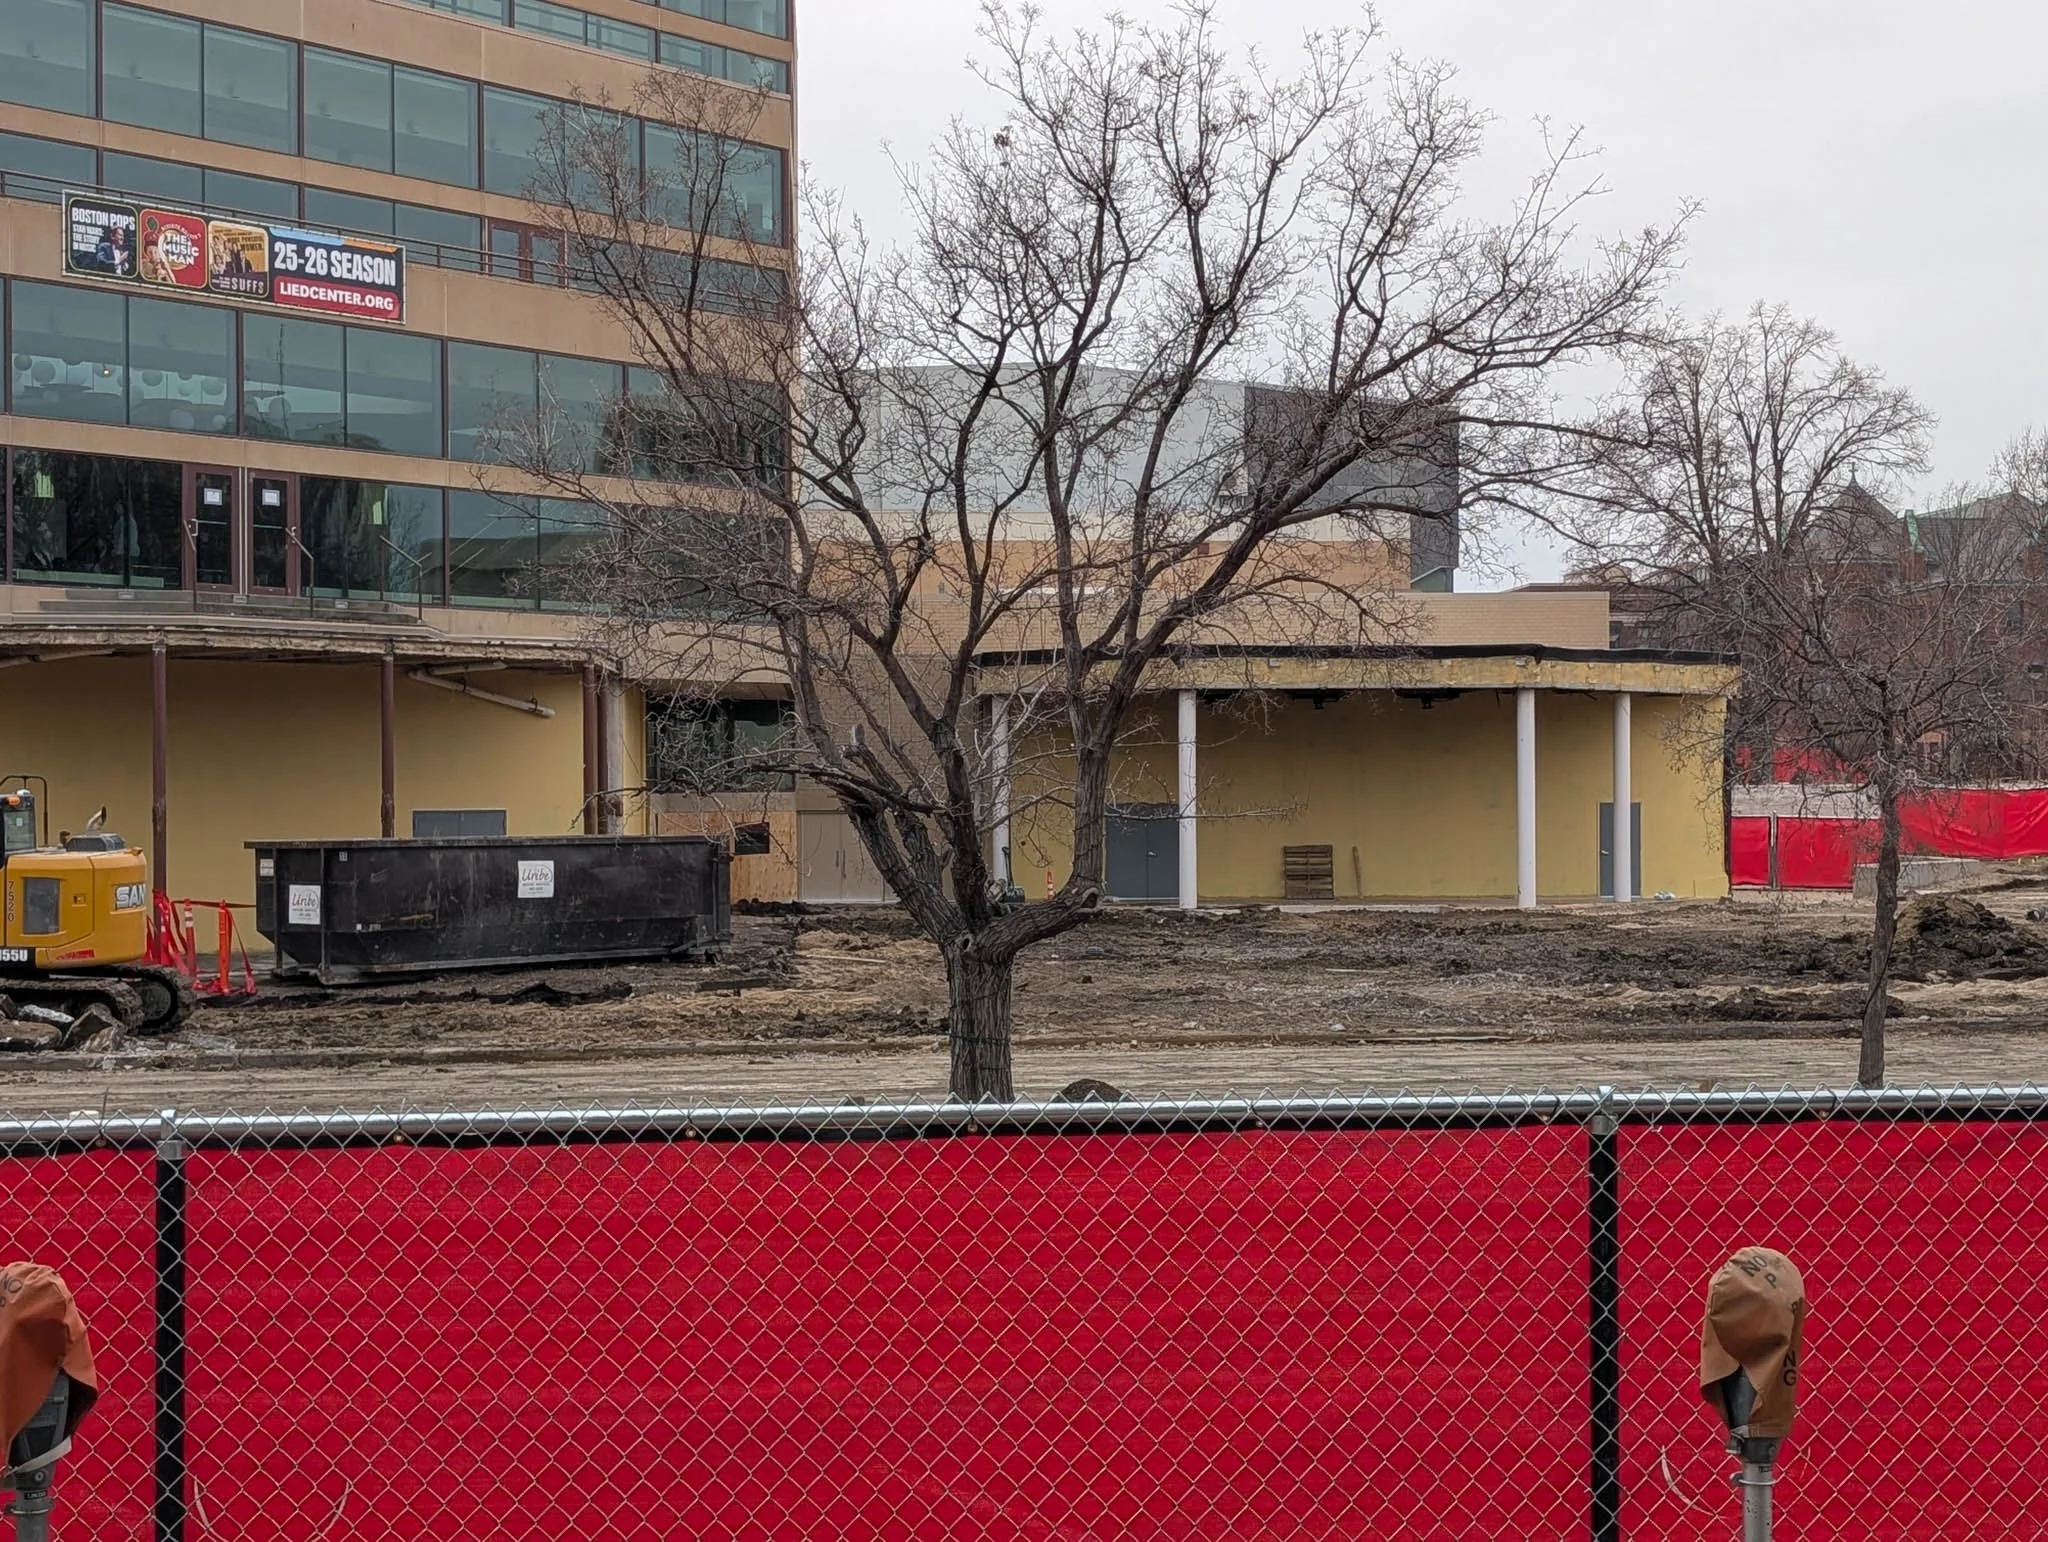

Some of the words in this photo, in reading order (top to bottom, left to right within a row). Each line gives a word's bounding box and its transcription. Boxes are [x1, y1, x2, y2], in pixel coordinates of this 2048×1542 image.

[72, 207, 109, 227] BOSTON
[110, 212, 135, 231] POPS
[162, 240, 200, 257] MUSIC
[166, 233, 188, 245] THE
[168, 254, 195, 265] MAN
[274, 241, 328, 276] 25-26
[330, 250, 397, 286] SEASON
[231, 277, 265, 294] SUFFS
[280, 282, 394, 311] LIEDCENTER.ORG
[1741, 1255, 1768, 1277] NO
